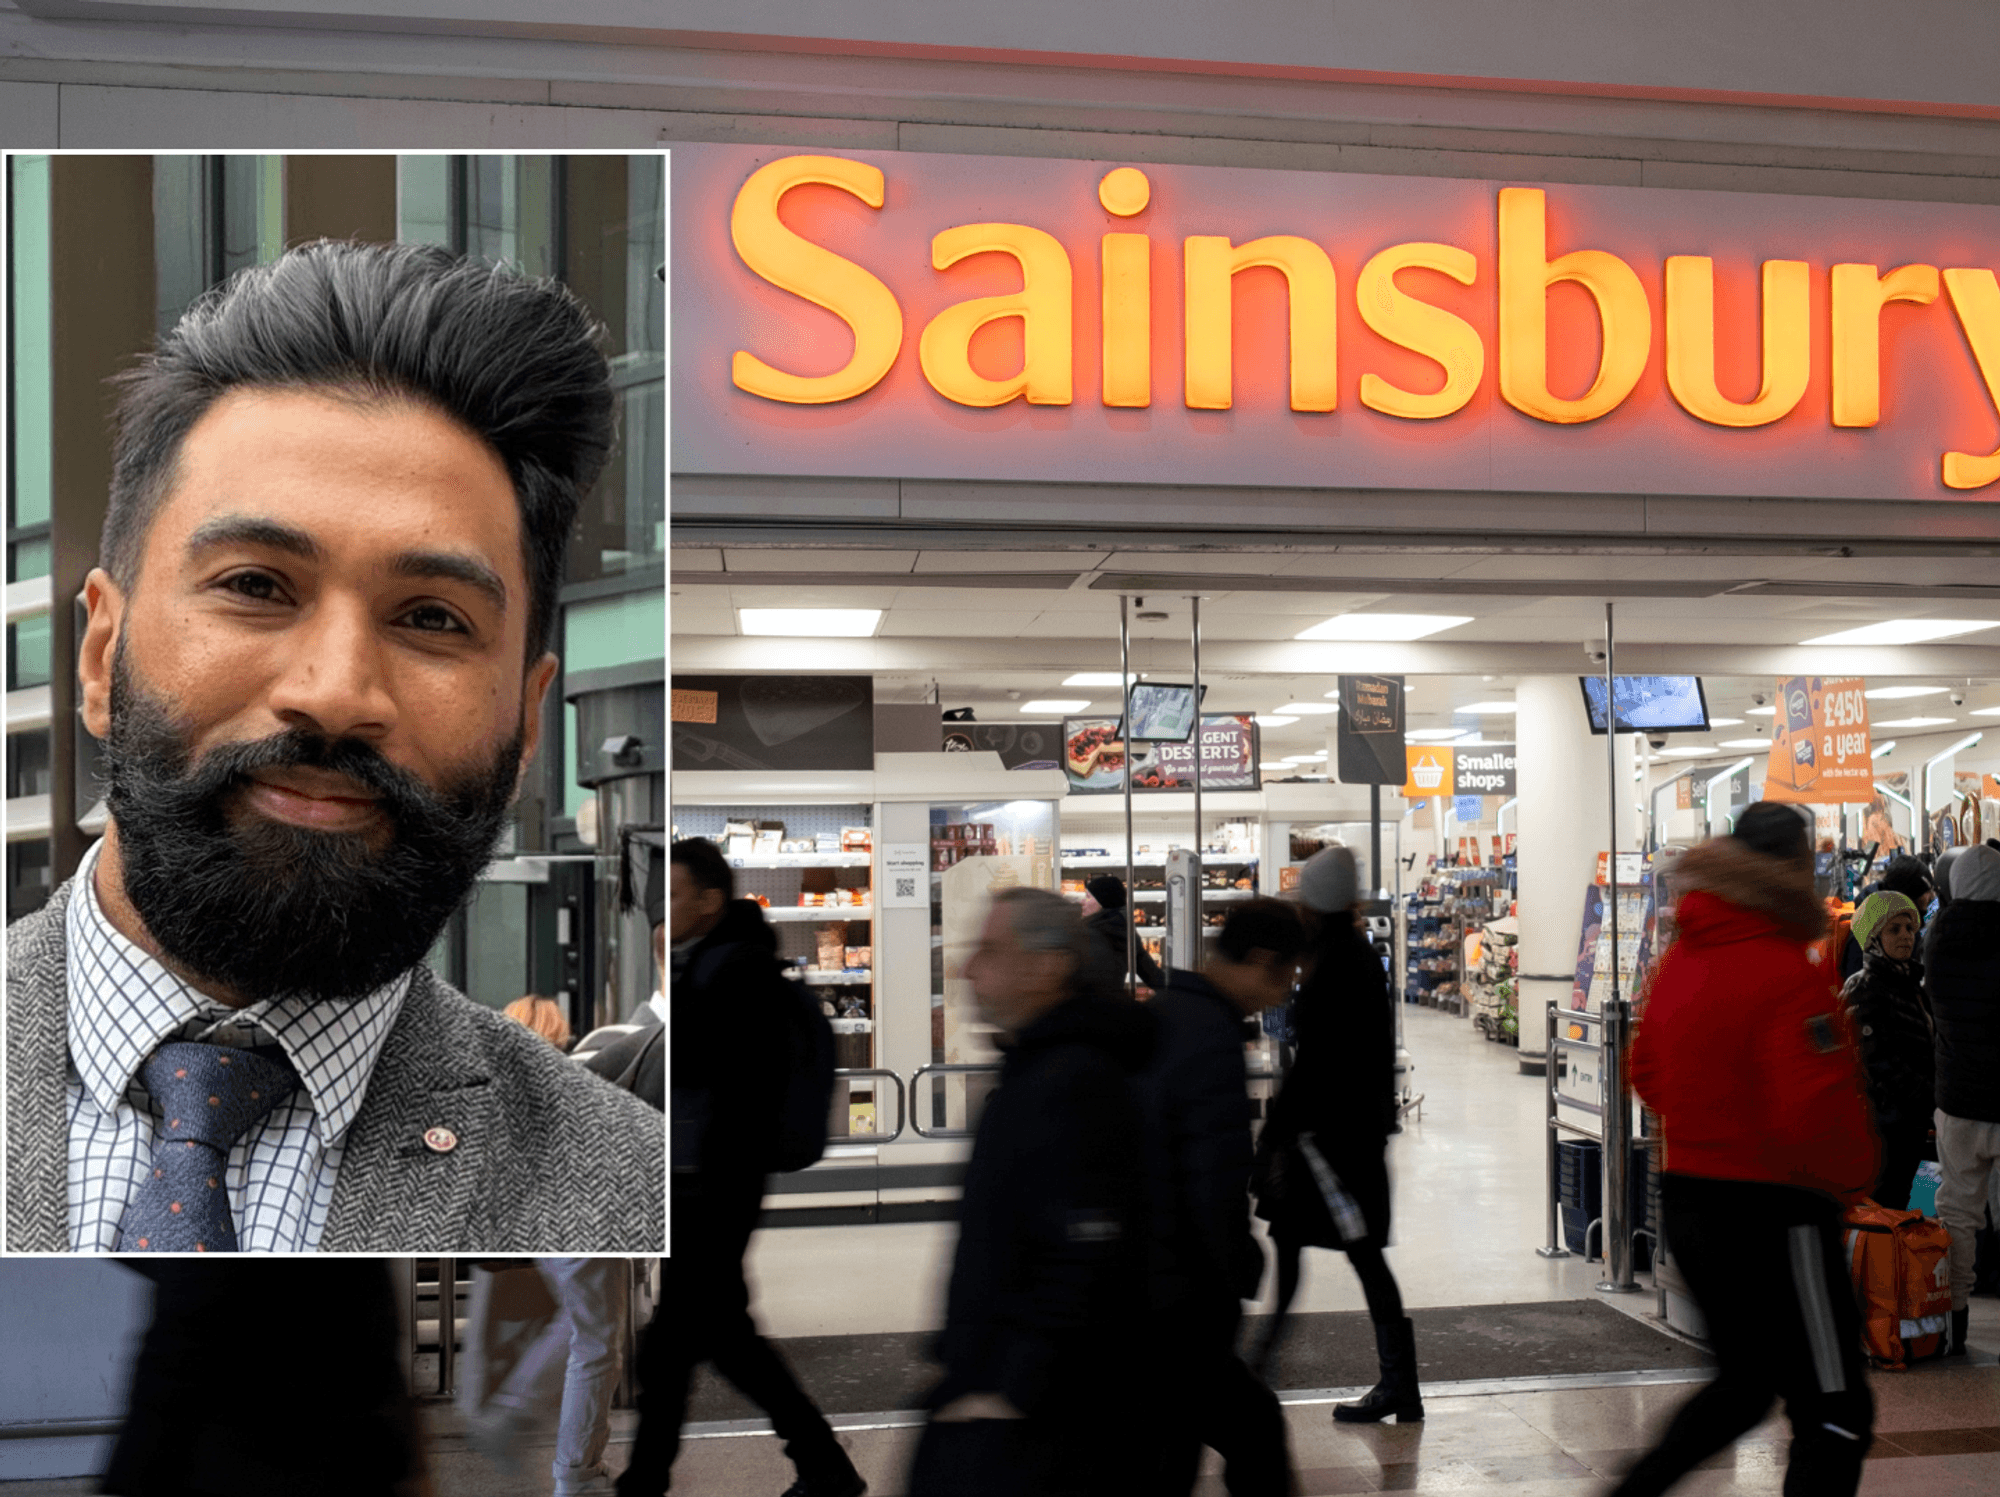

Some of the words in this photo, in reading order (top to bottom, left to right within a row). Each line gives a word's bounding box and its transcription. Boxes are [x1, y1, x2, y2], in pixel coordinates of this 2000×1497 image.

[1823, 734, 1833, 757] a
[1836, 732, 1867, 765] year
[1458, 771, 1506, 791] shops
